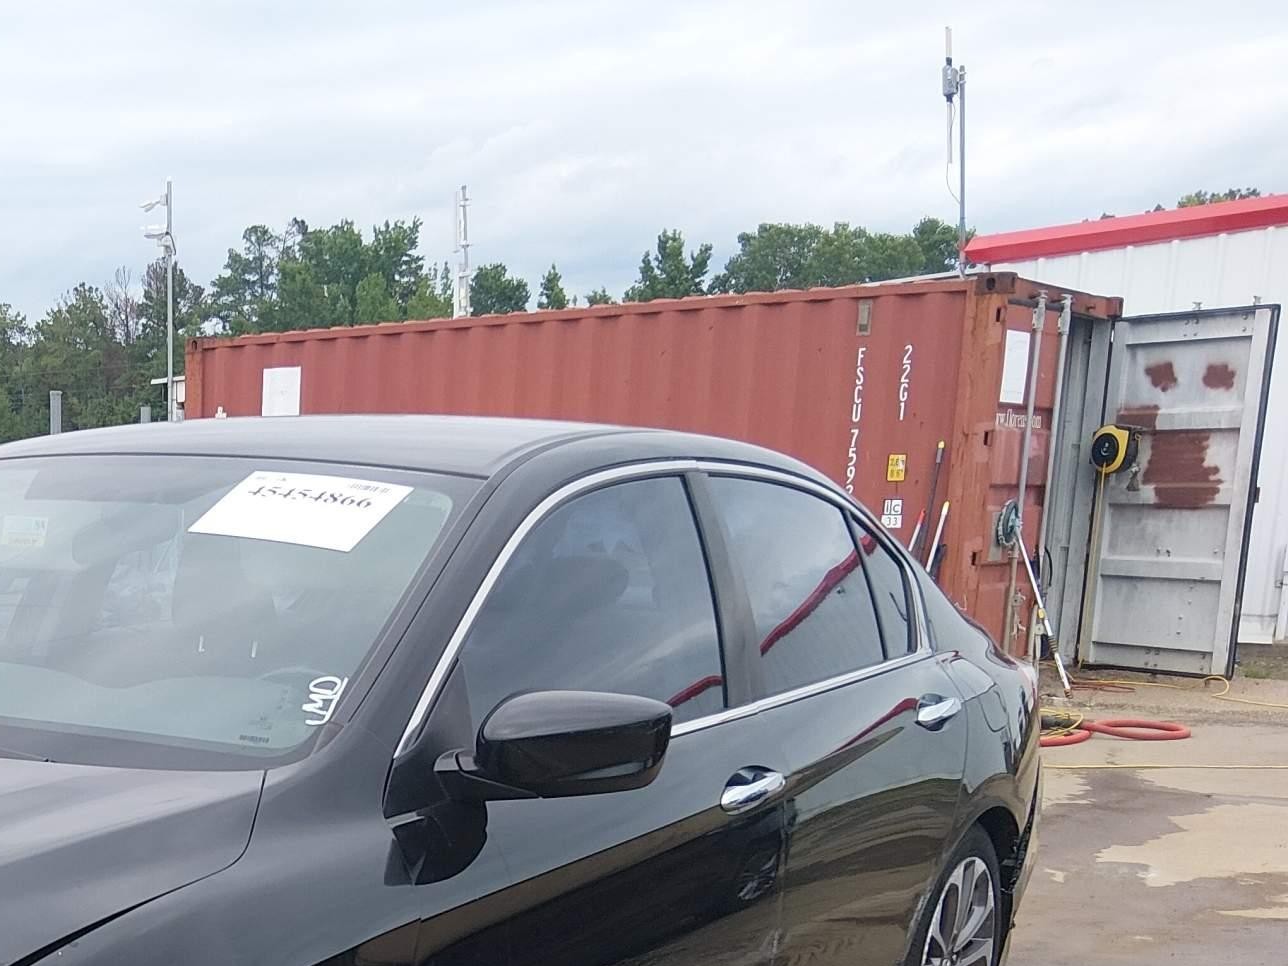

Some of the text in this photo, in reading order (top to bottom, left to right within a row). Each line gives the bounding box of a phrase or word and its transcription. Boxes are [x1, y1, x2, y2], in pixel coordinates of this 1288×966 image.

[852, 347, 867, 423] FSCU
[899, 344, 913, 421] 22G1
[247, 486, 372, 509] 45454866
[886, 517, 898, 527] 33
